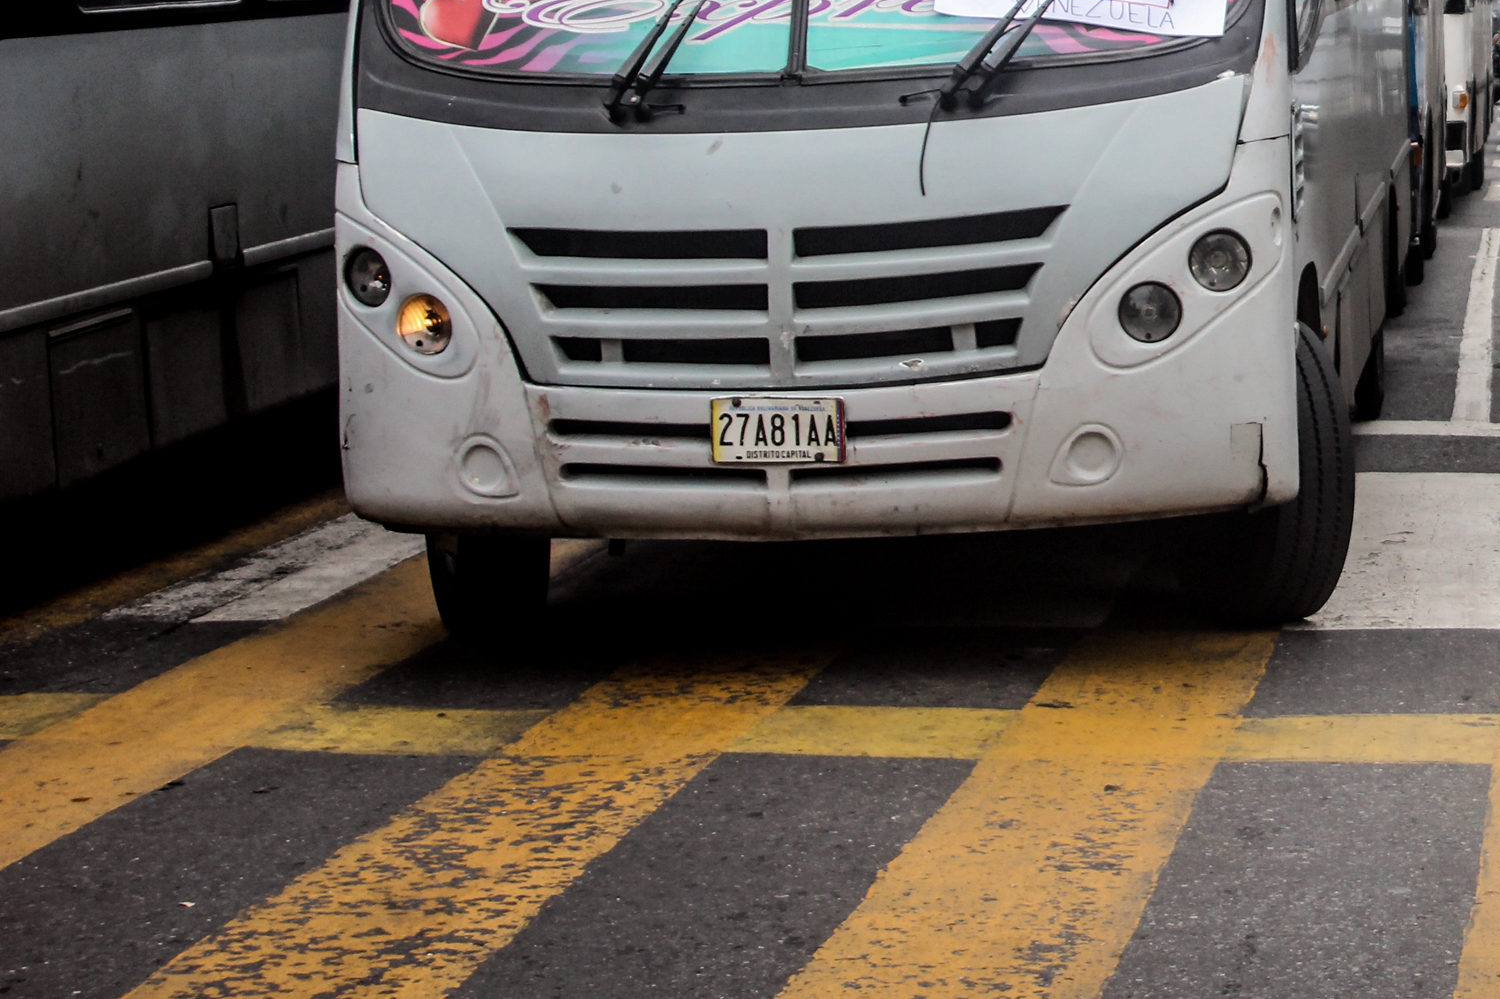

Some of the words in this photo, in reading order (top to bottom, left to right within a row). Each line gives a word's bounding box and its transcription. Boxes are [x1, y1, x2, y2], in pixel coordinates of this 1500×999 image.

[719, 412, 838, 447] 27A81AA
[746, 450, 780, 459] DISTRITO
[781, 450, 812, 459] CAPITAL
